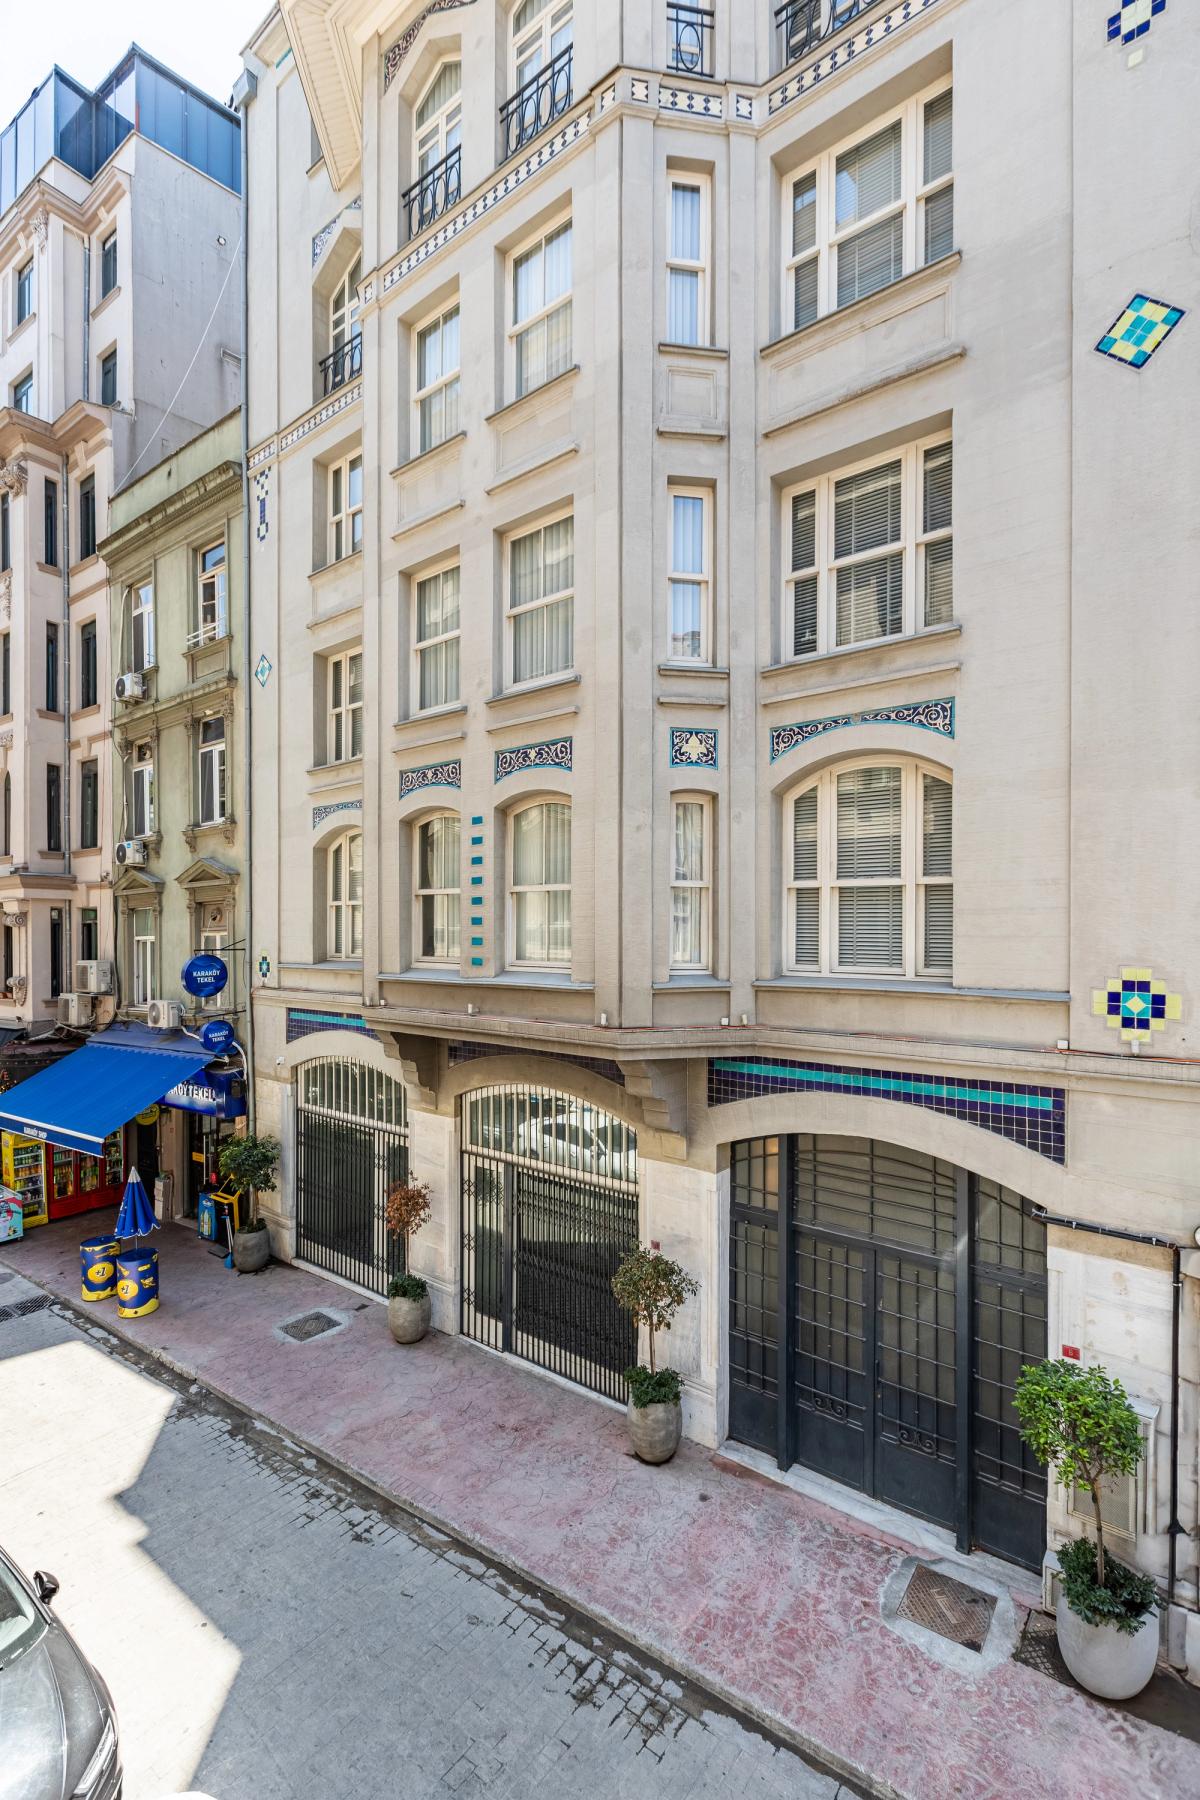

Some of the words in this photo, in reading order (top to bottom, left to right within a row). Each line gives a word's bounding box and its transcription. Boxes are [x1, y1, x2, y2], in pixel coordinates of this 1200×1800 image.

[193, 969, 220, 977] KARAKÖY
[208, 1030, 228, 1038] KARAKÖY
[188, 1085, 214, 1102] TEKEL
